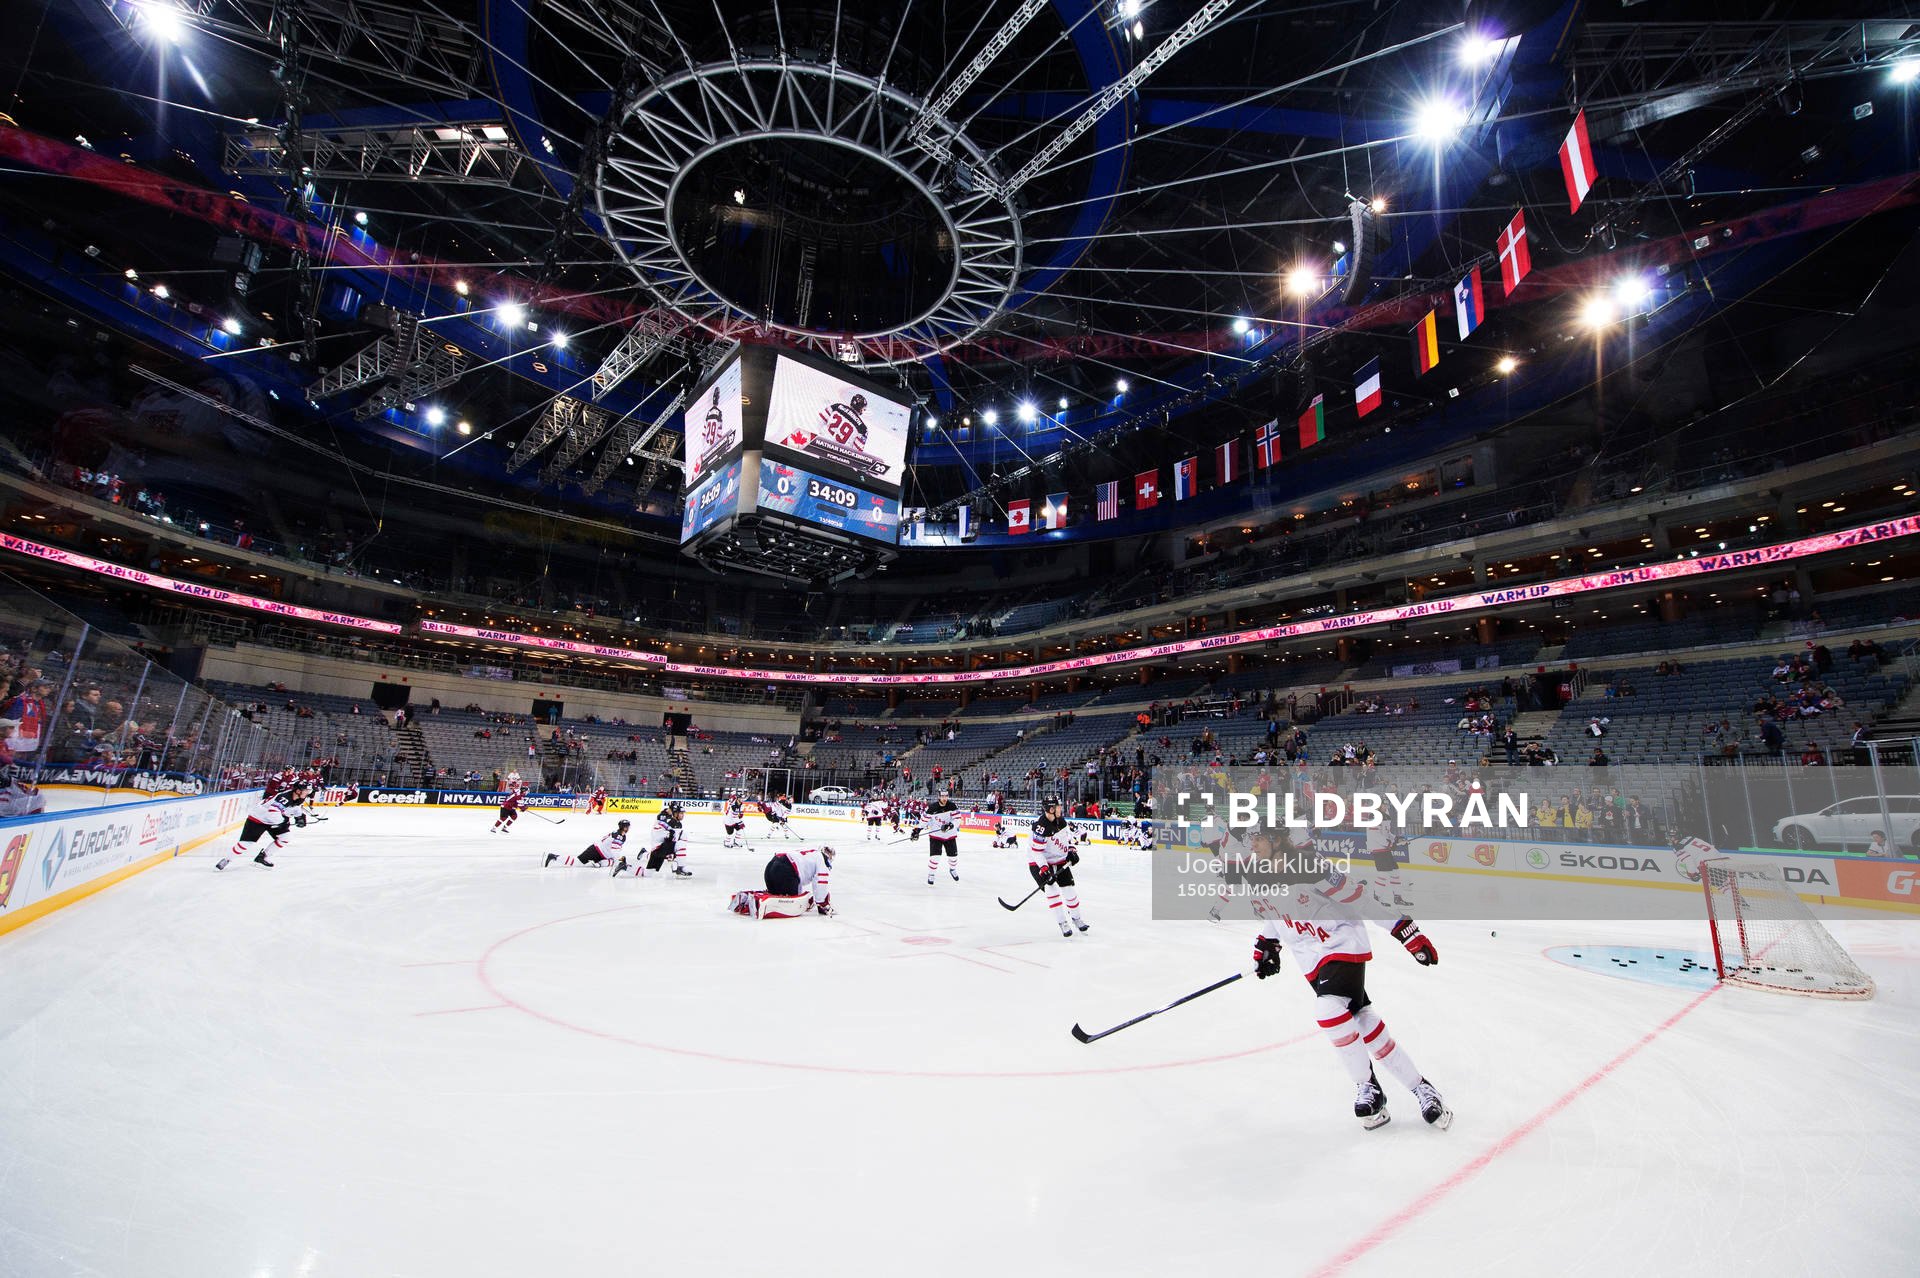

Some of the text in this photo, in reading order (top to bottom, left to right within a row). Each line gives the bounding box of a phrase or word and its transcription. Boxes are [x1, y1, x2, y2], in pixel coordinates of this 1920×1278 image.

[828, 414, 853, 444] 29
[875, 463, 886, 473] 29
[777, 477, 789, 493] 0
[809, 481, 856, 507] 34:09
[872, 507, 882, 521] 0
[4, 536, 45, 556] WARM
[1699, 551, 1761, 570] WARM
[173, 582, 229, 600] WARM UP
[1482, 586, 1549, 604] WARM UP
[323, 612, 355, 624] WARM
[1321, 616, 1355, 630] WARM
[477, 630, 520, 642] WARM UP
[1200, 635, 1240, 648] WARM UP
[594, 647, 619, 656] WARM
[785, 673, 806, 681] WARM
[368, 790, 427, 803] Ceresit
[444, 793, 506, 804] NIVEA ME
[1013, 818, 1035, 827] TISSO
[1035, 825, 1046, 835] 29
[1560, 851, 1661, 872] ŠKODA
